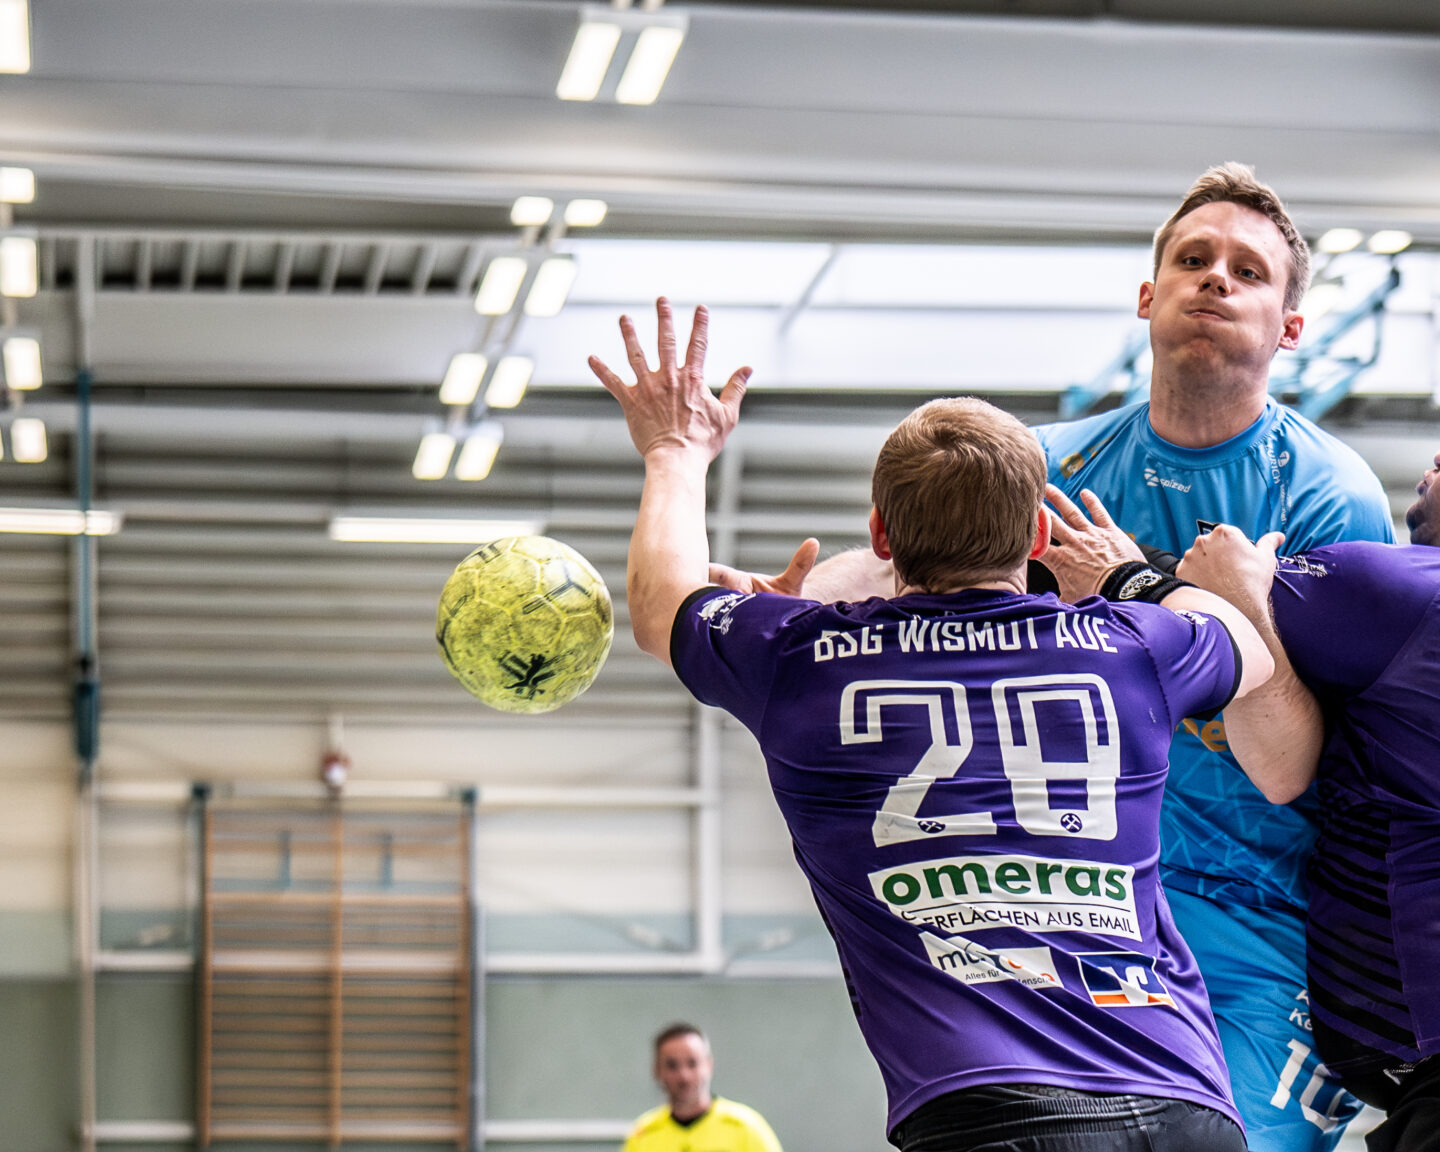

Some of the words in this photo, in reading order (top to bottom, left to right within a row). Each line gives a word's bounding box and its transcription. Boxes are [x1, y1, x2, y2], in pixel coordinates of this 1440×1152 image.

[1055, 611, 1118, 653] AUE
[840, 672, 1121, 848] 28
[881, 861, 1127, 906] omeras
[1047, 911, 1083, 928] AUS
[1090, 914, 1135, 934] EMAIL
